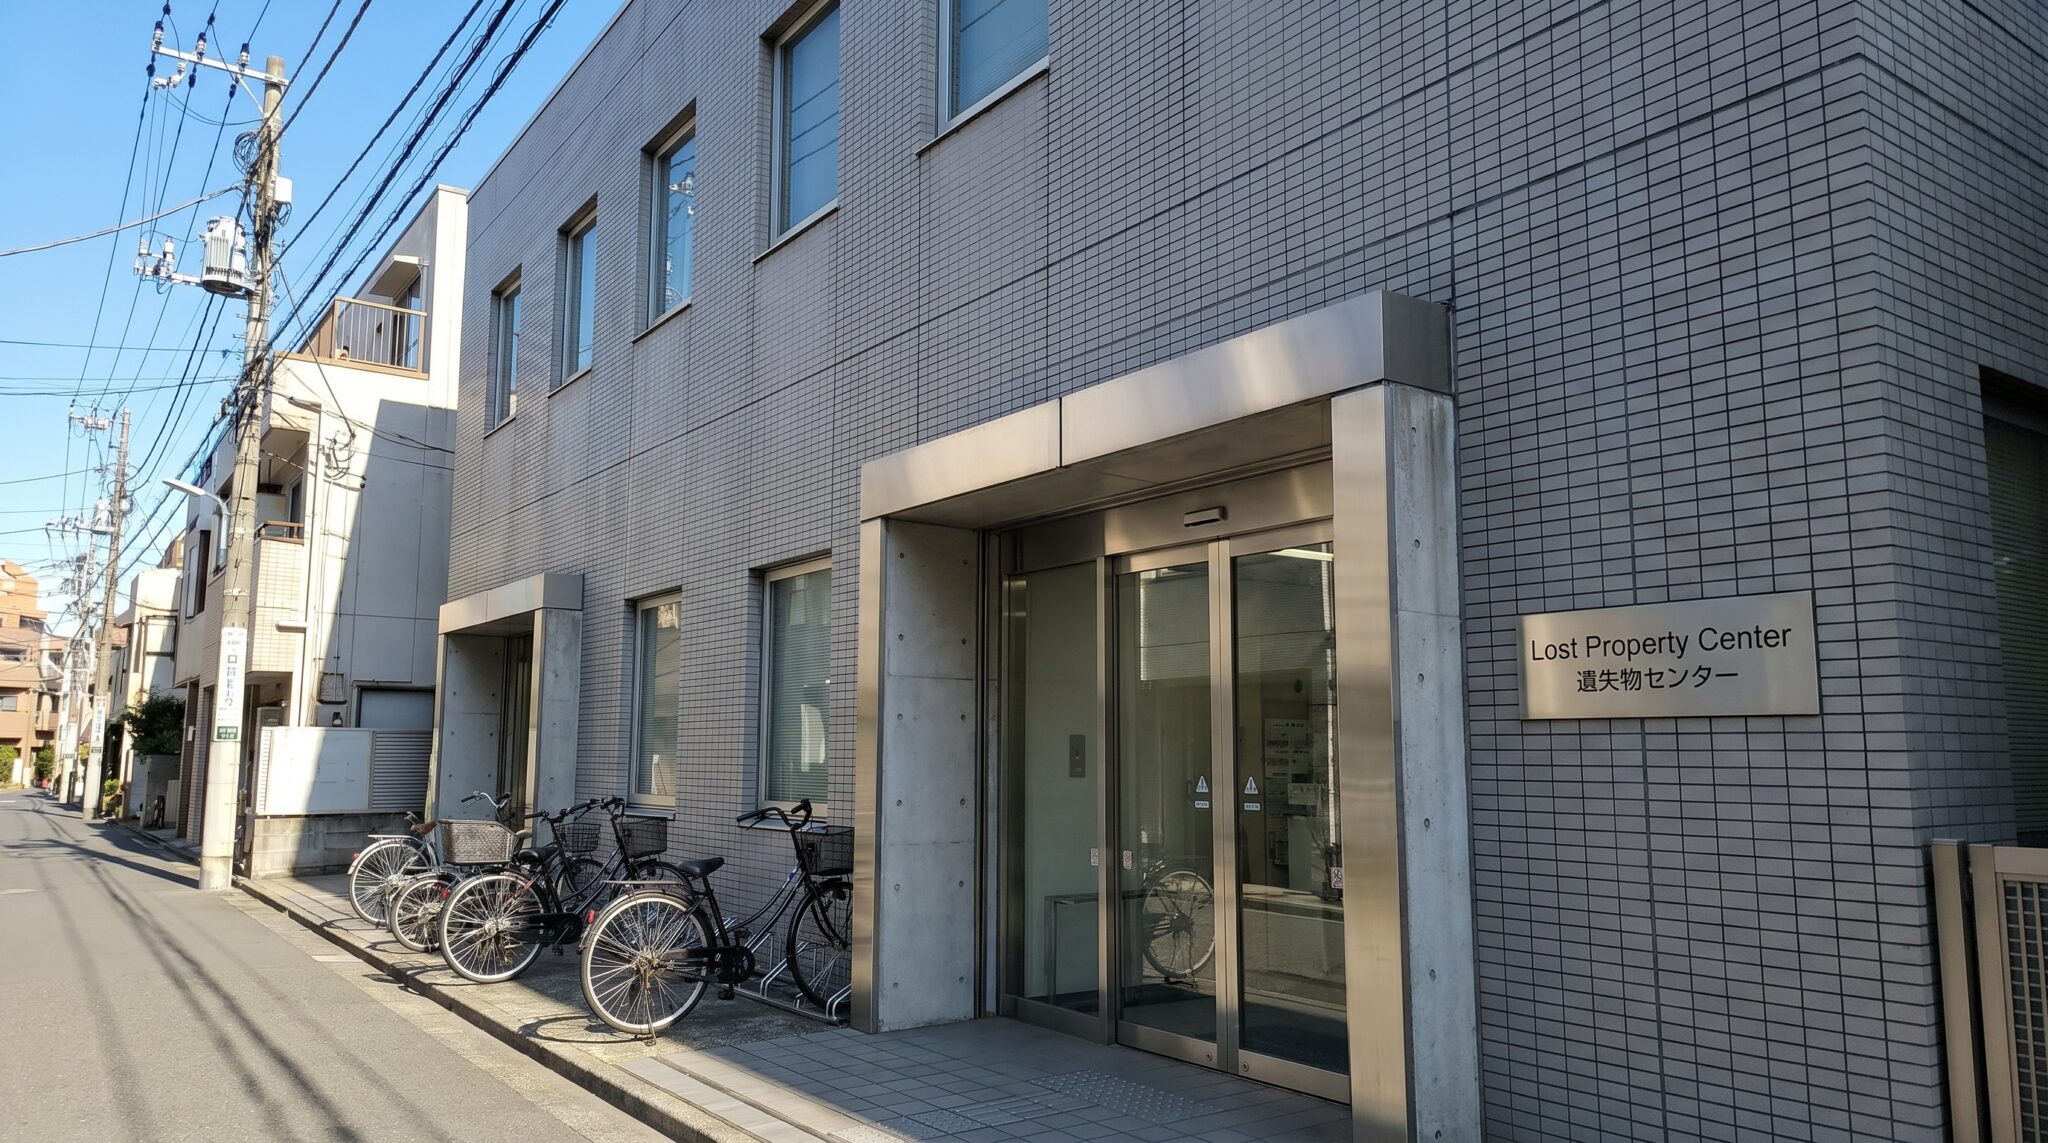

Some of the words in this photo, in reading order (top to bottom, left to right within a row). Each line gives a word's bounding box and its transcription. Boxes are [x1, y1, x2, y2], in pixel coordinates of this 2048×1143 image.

[1531, 638, 1578, 661] Lost
[1586, 630, 1689, 662] Property
[1698, 625, 1792, 652] Center
[1576, 665, 1739, 693] 遺失物センター
